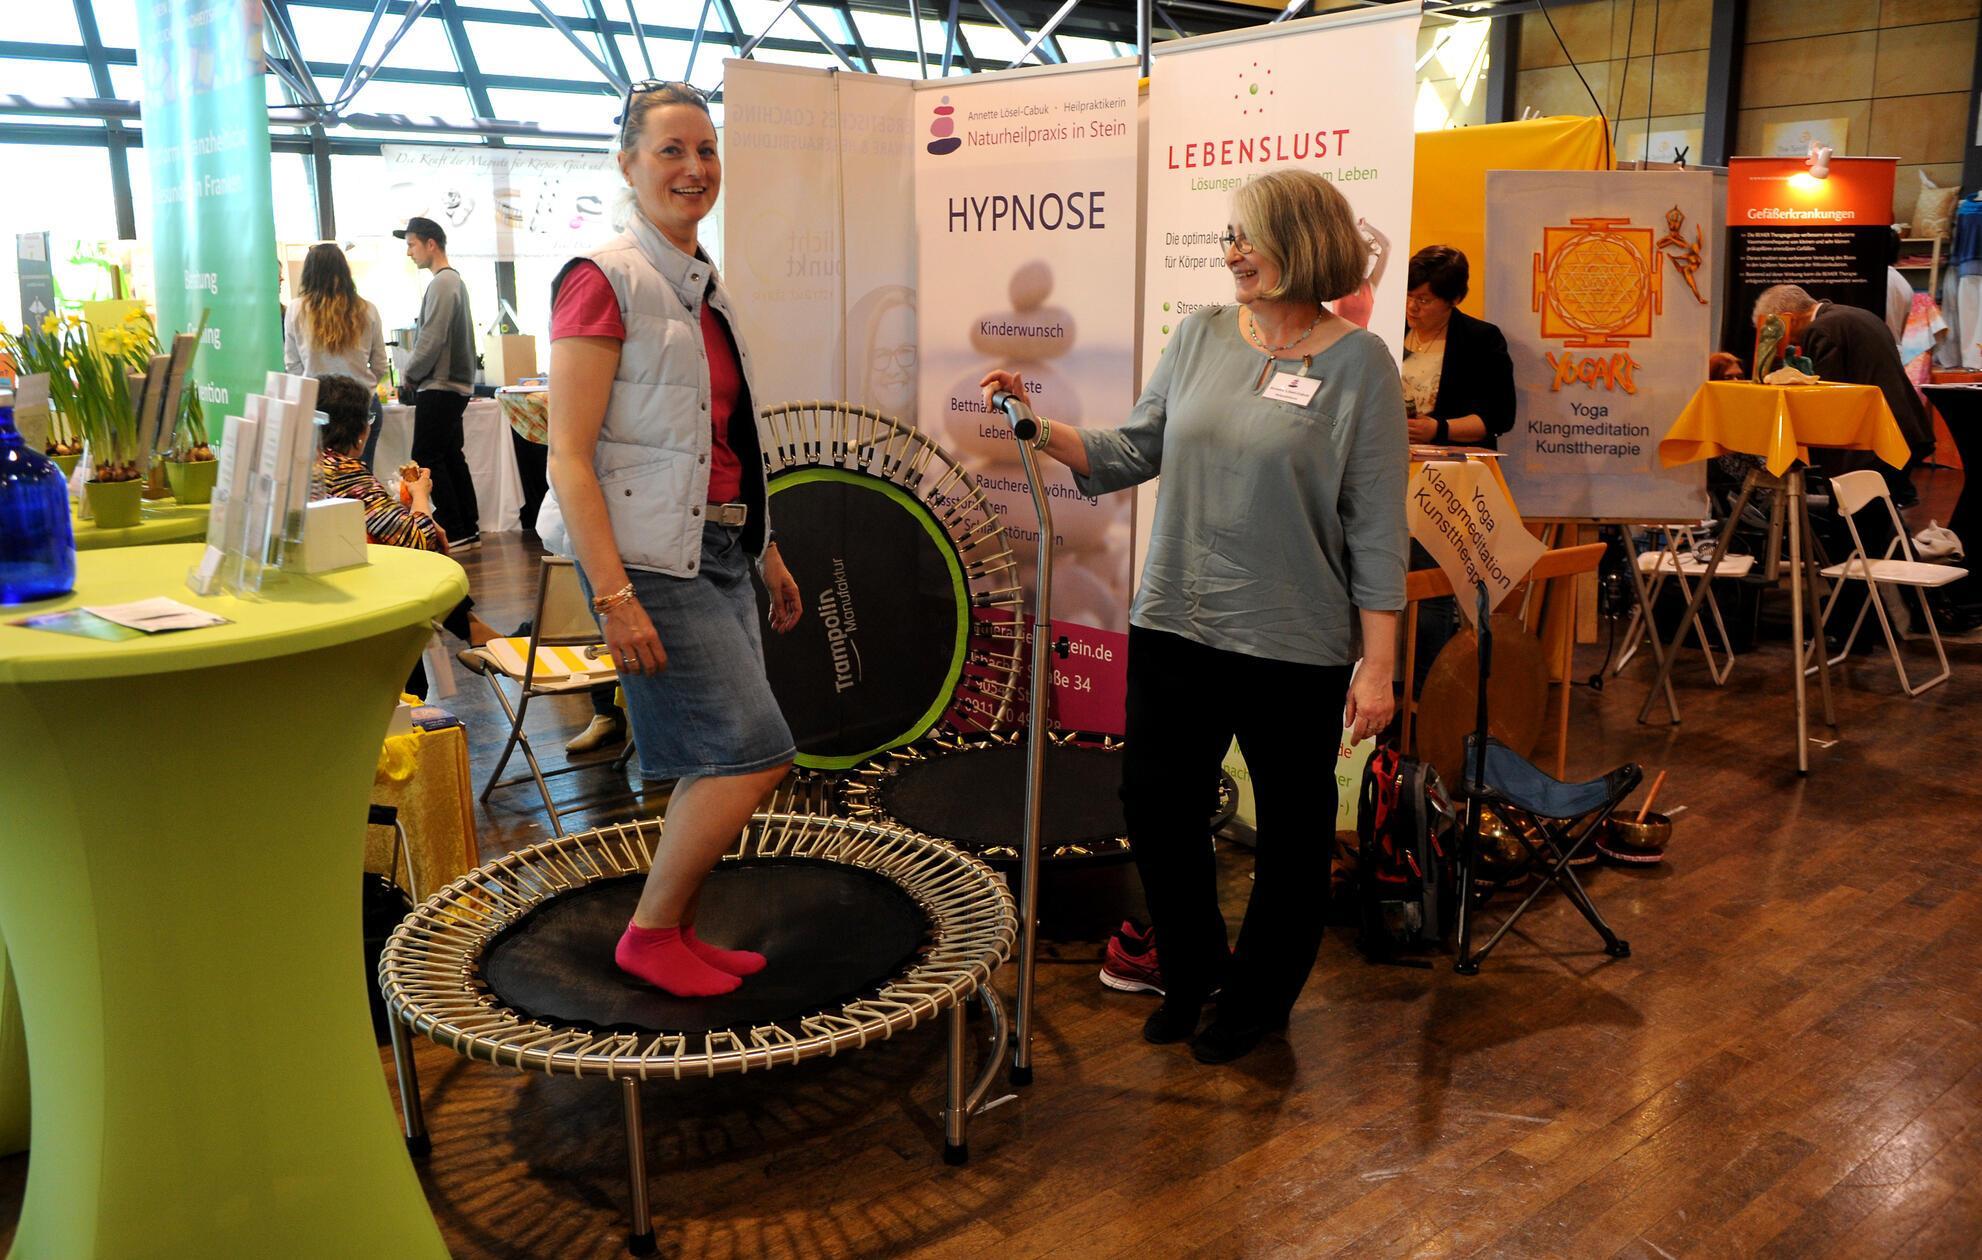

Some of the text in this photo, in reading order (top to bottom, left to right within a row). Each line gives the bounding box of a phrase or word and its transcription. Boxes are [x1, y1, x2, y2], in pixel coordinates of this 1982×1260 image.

[968, 97, 1126, 121] Annette Lösel-Cabuk Heilpraktikerin
[968, 119, 1126, 147] Naturheilpraxis in Stein
[1168, 129, 1350, 169] LEBENSLUST
[1191, 177, 1242, 192] Lösungen
[1338, 167, 1378, 182] Leben
[949, 191, 1105, 233] HYPNOSE
[1747, 208, 1855, 221] Gefäßerkrankungen
[1166, 232, 1180, 246] Die
[1182, 231, 1218, 247] optimale
[1165, 256, 1176, 268] für
[1179, 256, 1207, 270] Körper
[980, 321, 1064, 338] Kinderwunsch
[1571, 402, 1608, 420] Yoga
[979, 424, 1017, 441] Leben
[1528, 420, 1649, 439] Klangmeditation
[1536, 440, 1641, 458] Kunsttherapie
[1472, 485, 1495, 533] Yoga
[1422, 463, 1511, 589] Klangmeditation
[832, 558, 858, 633] Manufaktur
[818, 588, 854, 693] Trampolin
[1074, 674, 1092, 693] 34
